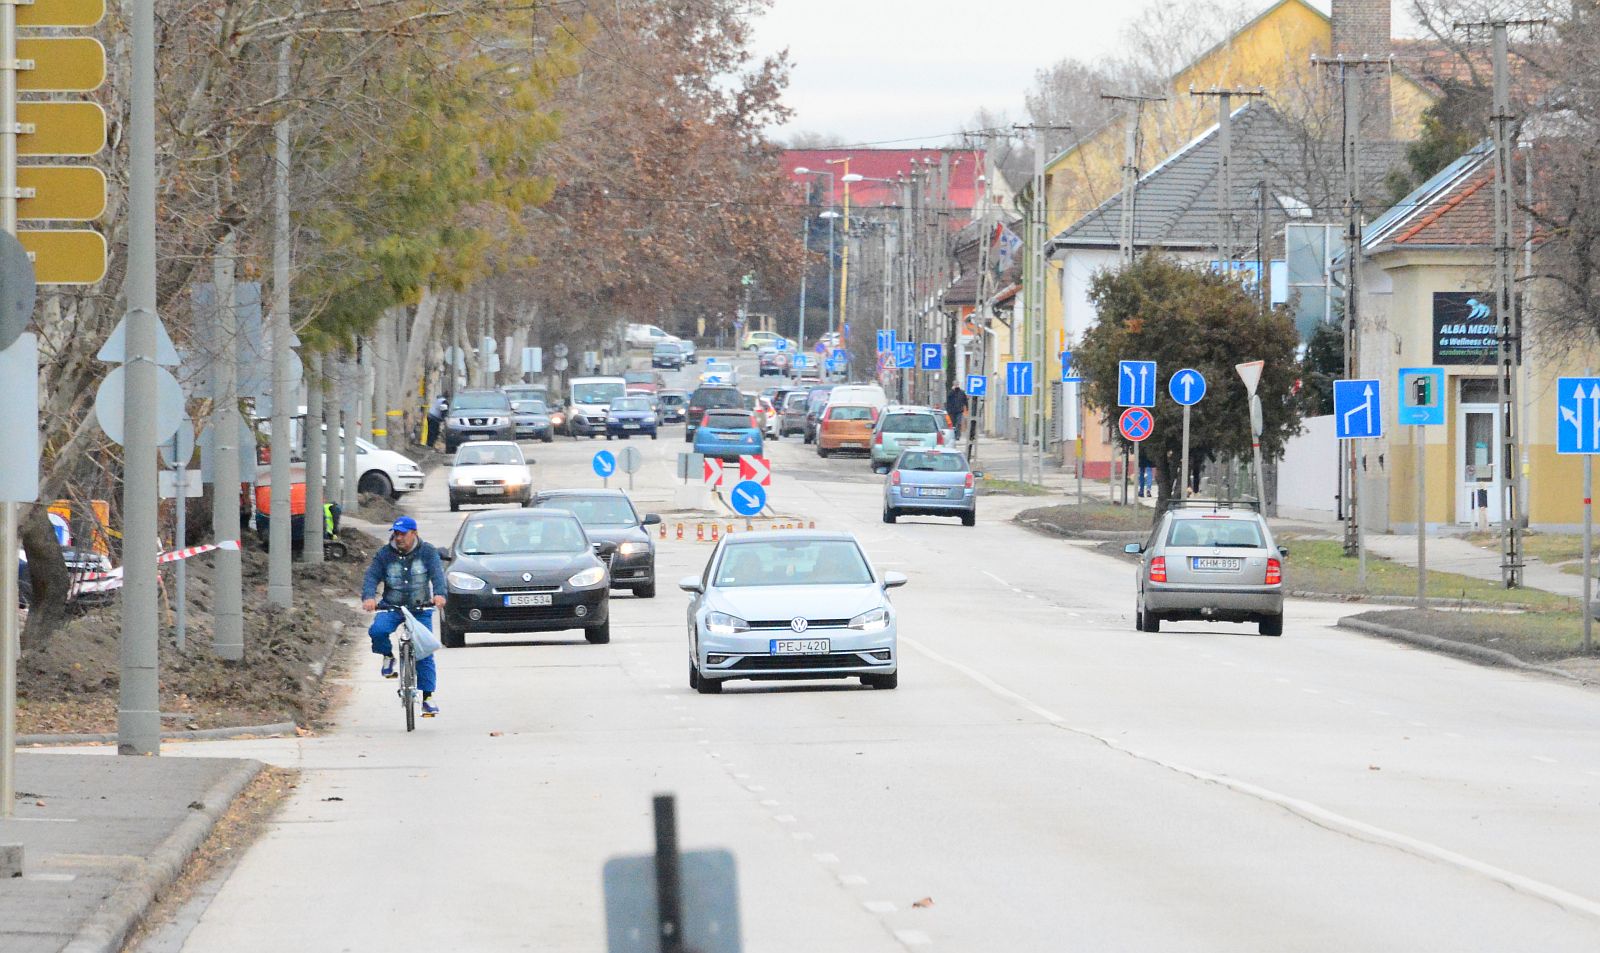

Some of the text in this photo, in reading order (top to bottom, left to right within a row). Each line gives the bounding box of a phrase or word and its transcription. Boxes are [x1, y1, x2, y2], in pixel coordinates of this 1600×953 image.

[1440, 324, 1466, 334] ALBA
[777, 340, 786, 349] P
[1449, 337, 1482, 346] Wellness
[924, 348, 938, 367] P
[969, 377, 984, 393] P
[1200, 559, 1238, 569] KHM-895
[510, 595, 551, 605] LSG-534
[778, 641, 827, 652] PEJ-420
